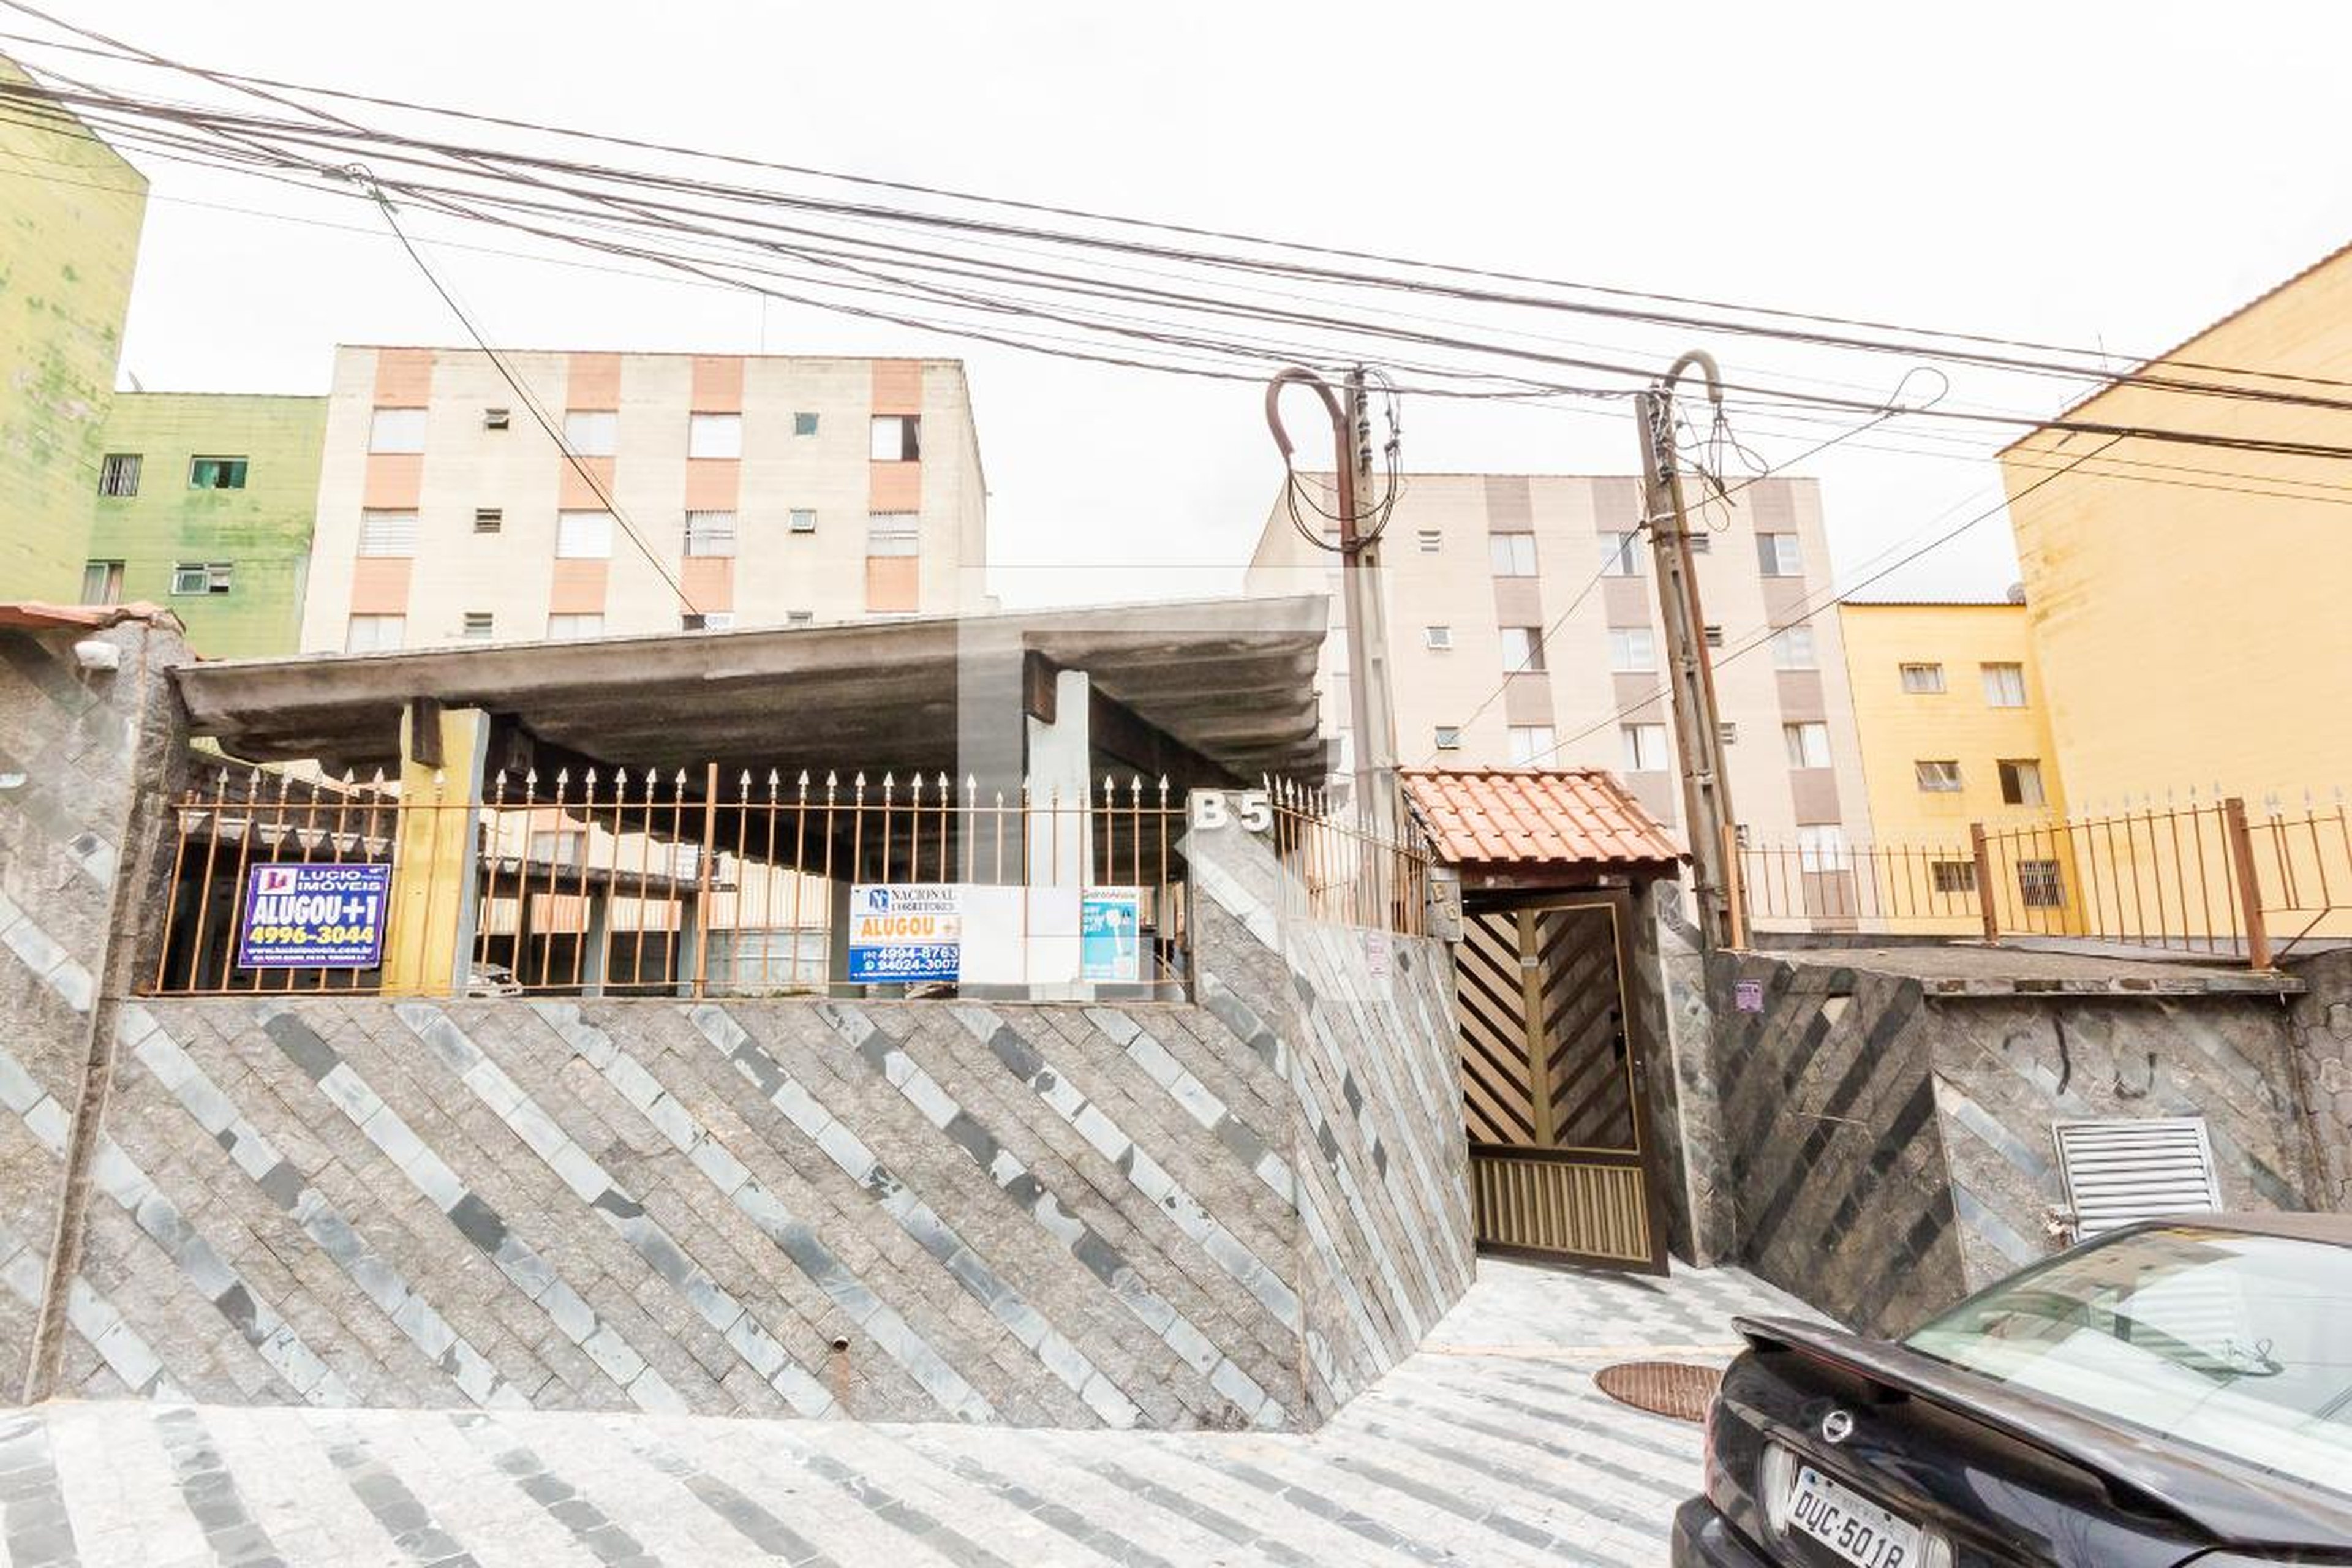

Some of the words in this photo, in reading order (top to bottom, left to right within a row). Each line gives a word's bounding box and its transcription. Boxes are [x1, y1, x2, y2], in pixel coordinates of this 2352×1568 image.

[1193, 792, 1227, 828] B
[1241, 793, 1272, 831] 5
[891, 889, 956, 900] NACIONAL
[249, 925, 375, 944] 4996-3044
[861, 917, 935, 937] ALUGOU
